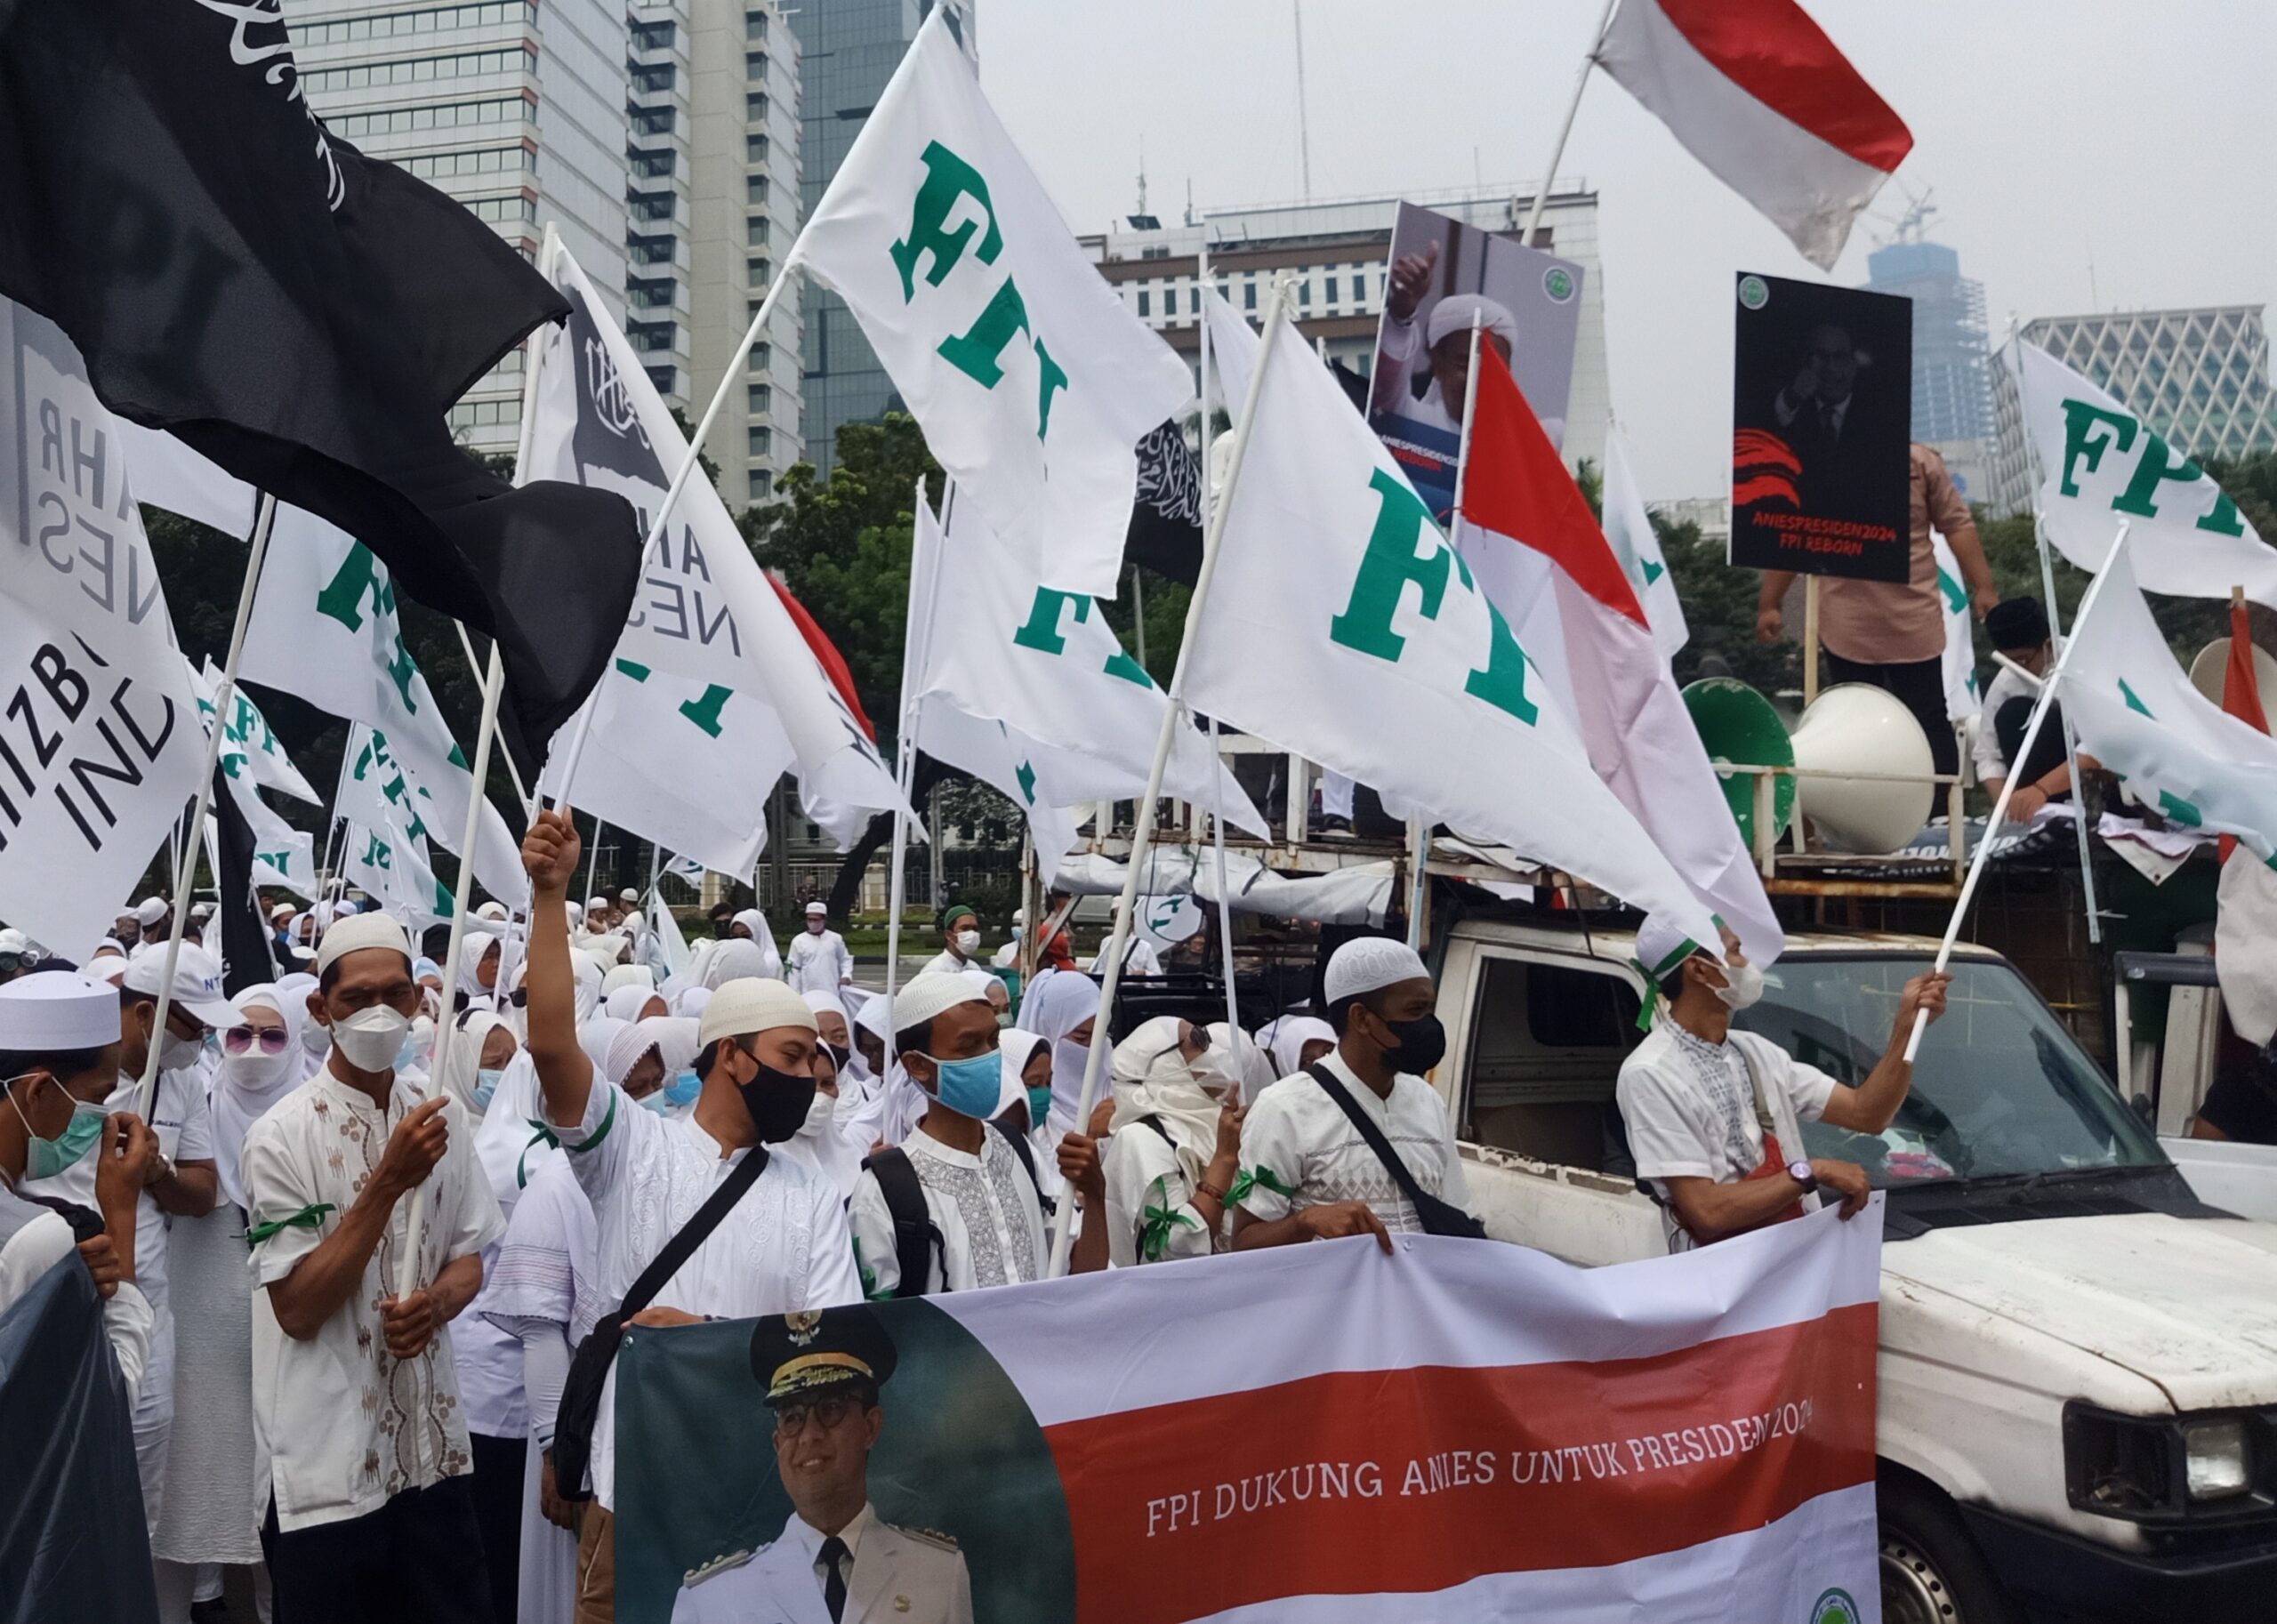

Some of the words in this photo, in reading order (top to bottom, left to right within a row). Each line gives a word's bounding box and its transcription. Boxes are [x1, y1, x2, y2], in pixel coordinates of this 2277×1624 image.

[1752, 511, 1896, 542] ANIESPRESIDEN2024
[1780, 533, 1801, 549] FPI
[1805, 536, 1864, 556] REBORN
[1146, 1488, 1202, 1538] FPI
[1214, 1461, 1383, 1520] DUKUNG
[1399, 1450, 1496, 1497] ANIES
[1510, 1439, 1629, 1484] UNTUK
[1633, 1411, 1771, 1474] PRESIDEN
